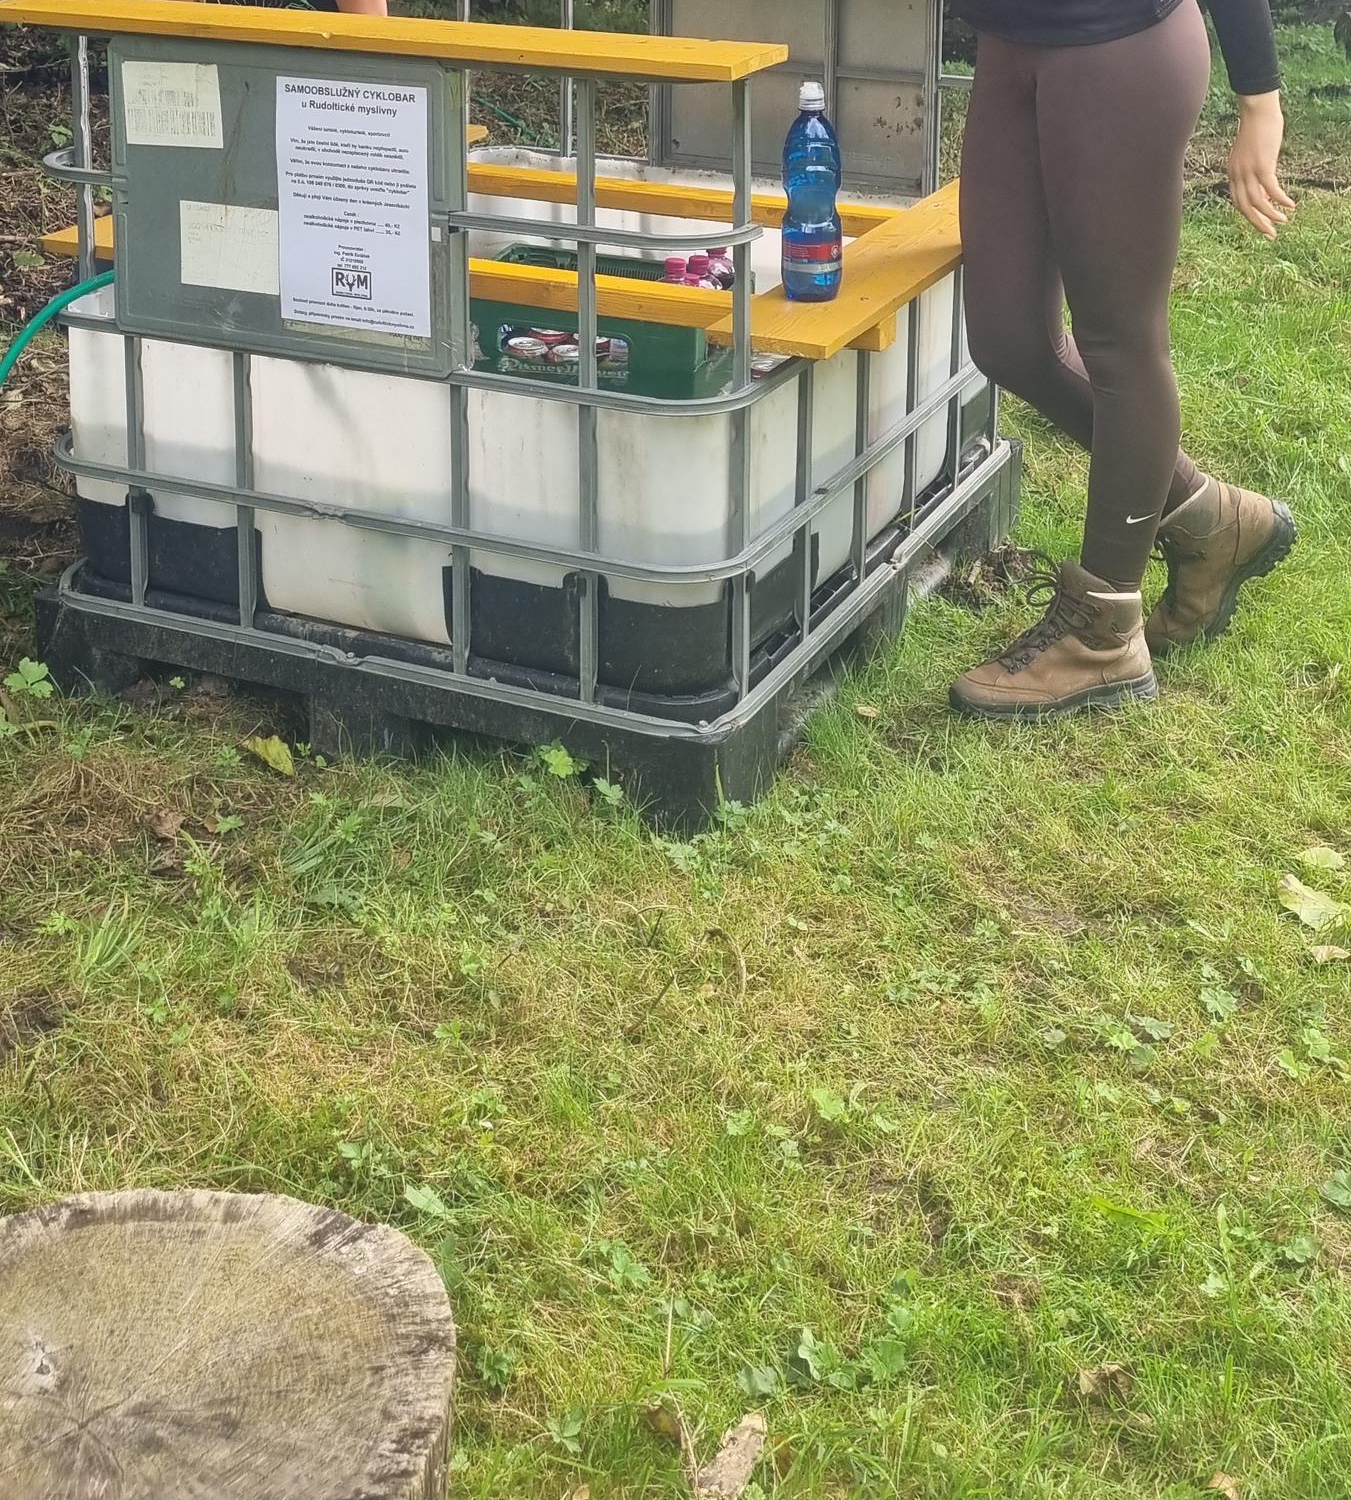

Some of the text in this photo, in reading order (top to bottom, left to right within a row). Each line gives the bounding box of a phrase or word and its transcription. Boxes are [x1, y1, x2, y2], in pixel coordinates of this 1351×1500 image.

[284, 83, 416, 103] SAMOOBSLUŽNÝ CYKLOBAR
[309, 100, 356, 112] Rudoltické
[357, 105, 397, 118] myslivny
